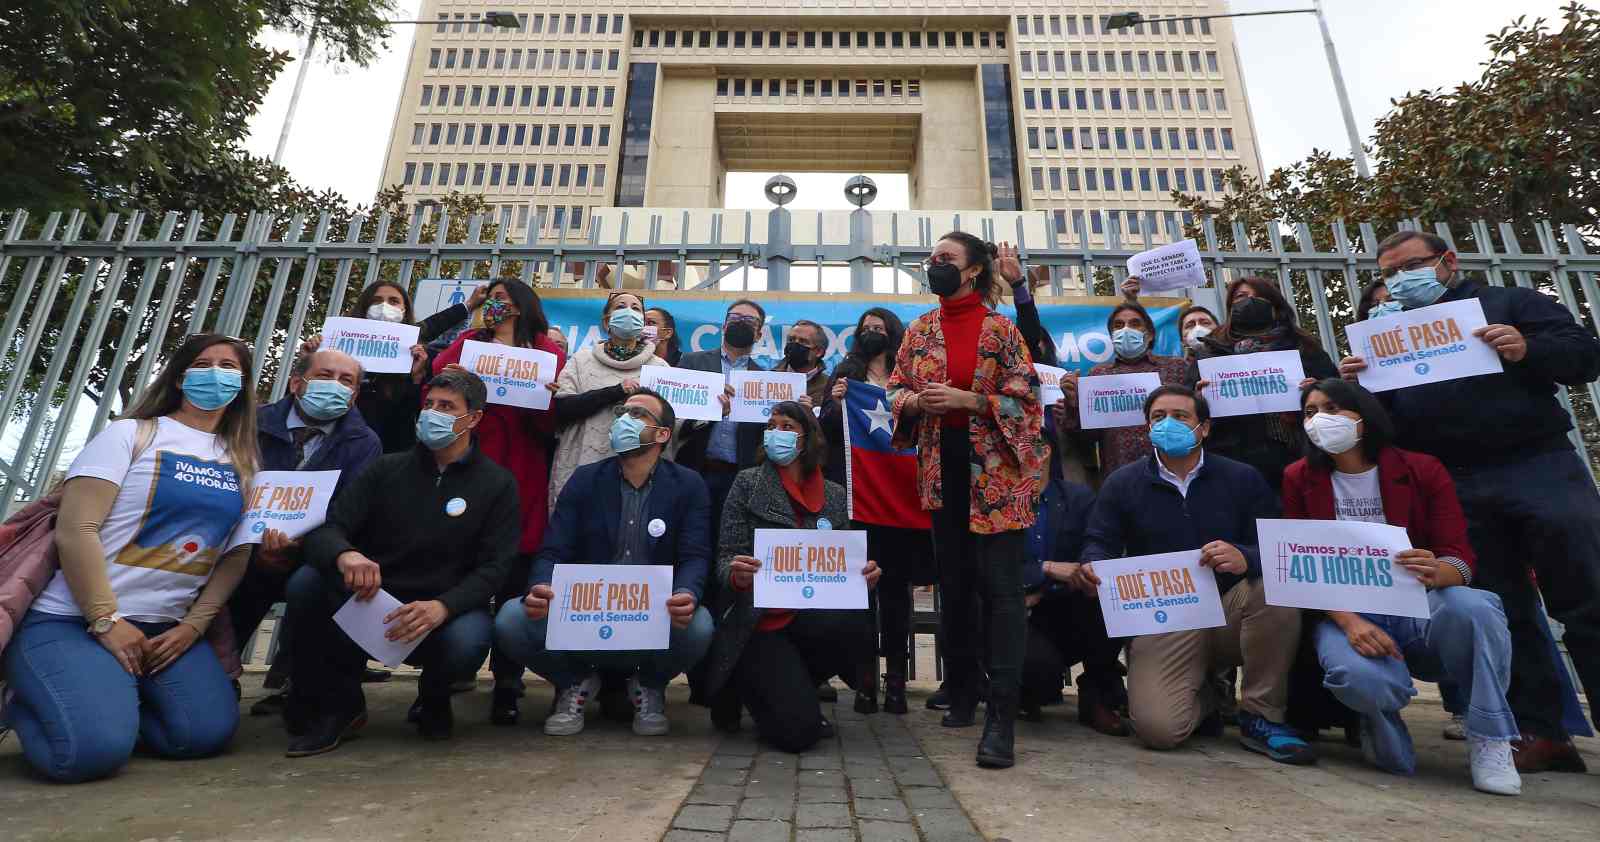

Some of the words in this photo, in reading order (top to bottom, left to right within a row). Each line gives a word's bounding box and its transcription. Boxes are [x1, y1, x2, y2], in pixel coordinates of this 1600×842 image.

[1141, 264, 1160, 273] PONGA
[1170, 258, 1188, 267] TABLA
[1161, 252, 1184, 262] SENADO
[1176, 264, 1184, 272] DE
[1185, 262, 1196, 270] LEY
[1408, 318, 1463, 350] PASA
[356, 338, 400, 359] HORAS
[1378, 356, 1401, 367] con
[1403, 352, 1416, 363] el
[1417, 343, 1467, 360] Senado
[504, 358, 539, 380] PASA
[493, 375, 502, 384] el
[503, 377, 537, 389] Senado
[1219, 379, 1239, 398] 40
[1240, 374, 1289, 396] HORAS
[671, 386, 709, 406] HORAS
[767, 382, 793, 401] PASA
[1094, 396, 1109, 413] 40
[174, 471, 195, 482] 40
[176, 461, 222, 479] ¡VAMOS
[268, 486, 314, 511] PASA
[263, 510, 306, 520] Senado
[807, 545, 847, 573] PASA
[1366, 545, 1390, 557] las
[774, 574, 794, 583] con
[795, 572, 805, 583] el
[807, 573, 847, 583] Senado
[1289, 554, 1317, 583] 40
[1321, 555, 1393, 588] HORAS
[1150, 567, 1196, 597] PASA
[607, 583, 650, 611] PASA
[1122, 601, 1143, 611] con
[1144, 598, 1155, 609] el
[1156, 594, 1199, 608] Senado
[570, 613, 591, 622] con
[593, 612, 604, 622] el
[606, 612, 649, 622] Senado
